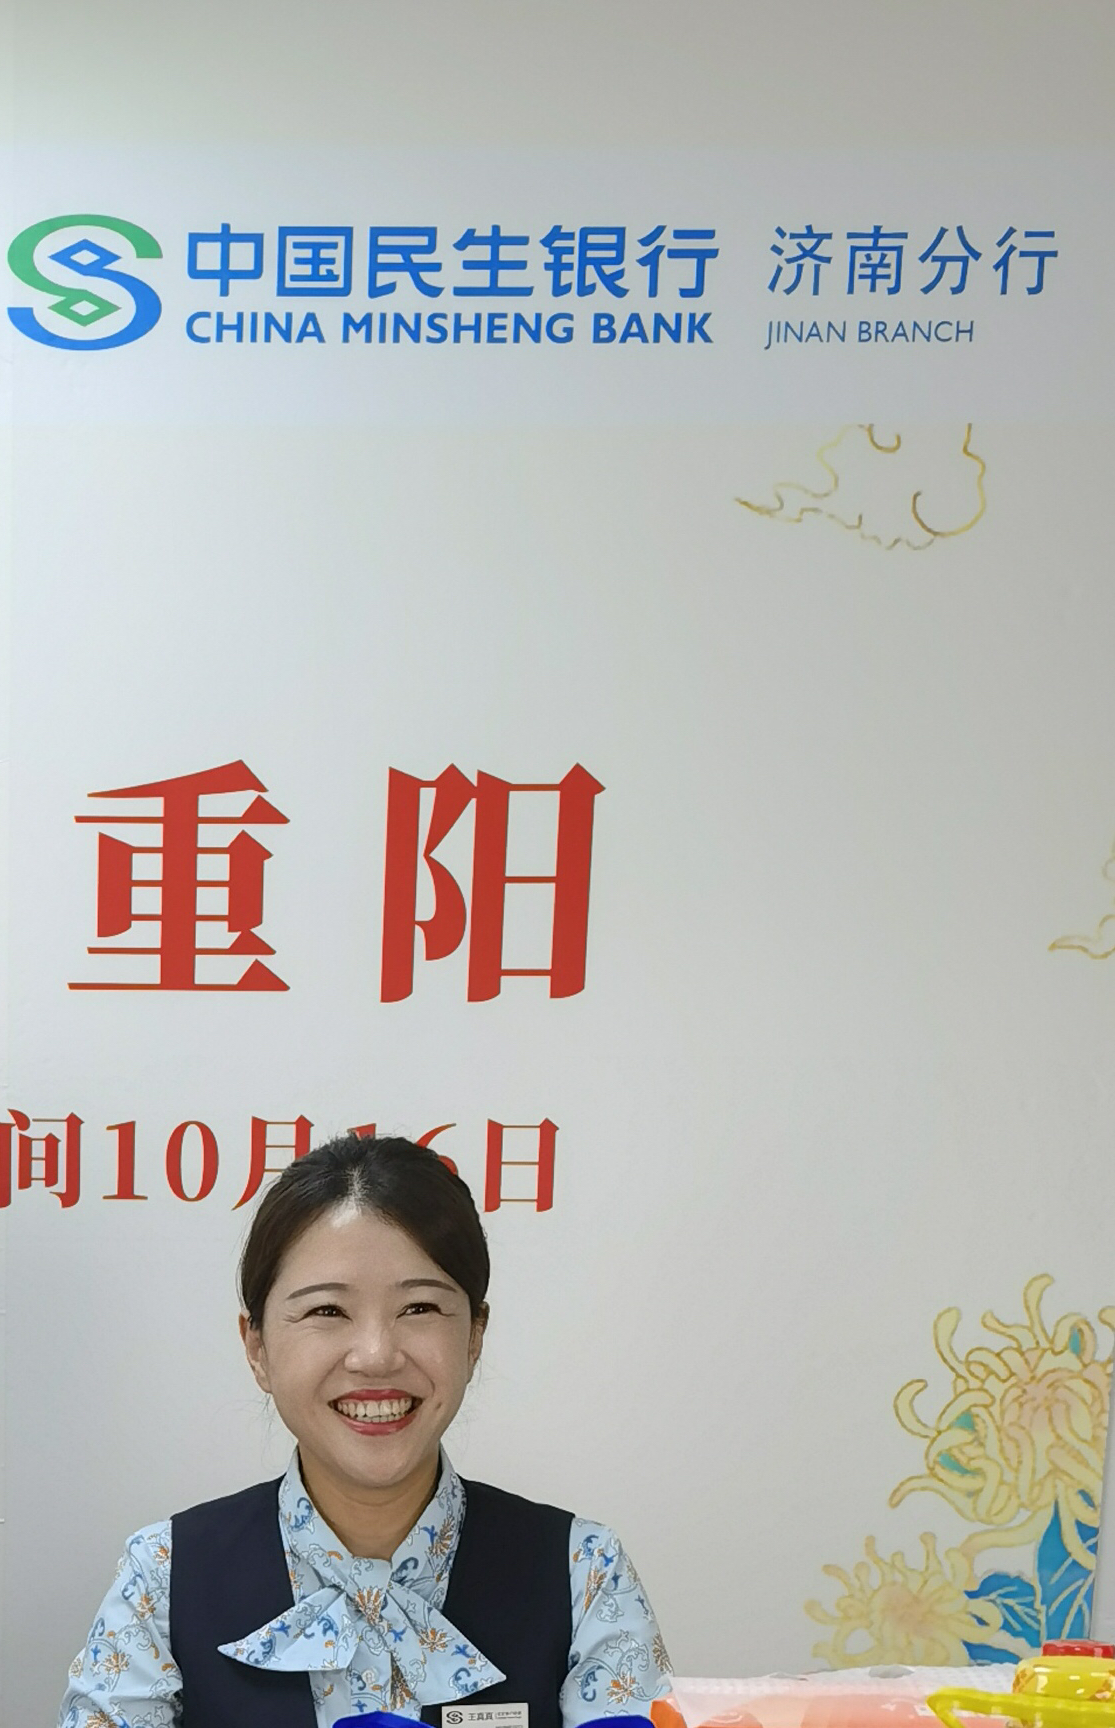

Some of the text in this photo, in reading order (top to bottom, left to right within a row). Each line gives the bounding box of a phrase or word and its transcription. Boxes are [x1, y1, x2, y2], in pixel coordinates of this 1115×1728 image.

[185, 223, 720, 299] 中国民生银行
[766, 224, 1061, 298] 济南分行
[185, 311, 715, 346] CHINA MINSHENG BANK
[764, 319, 977, 350] JINAN BRANCH
